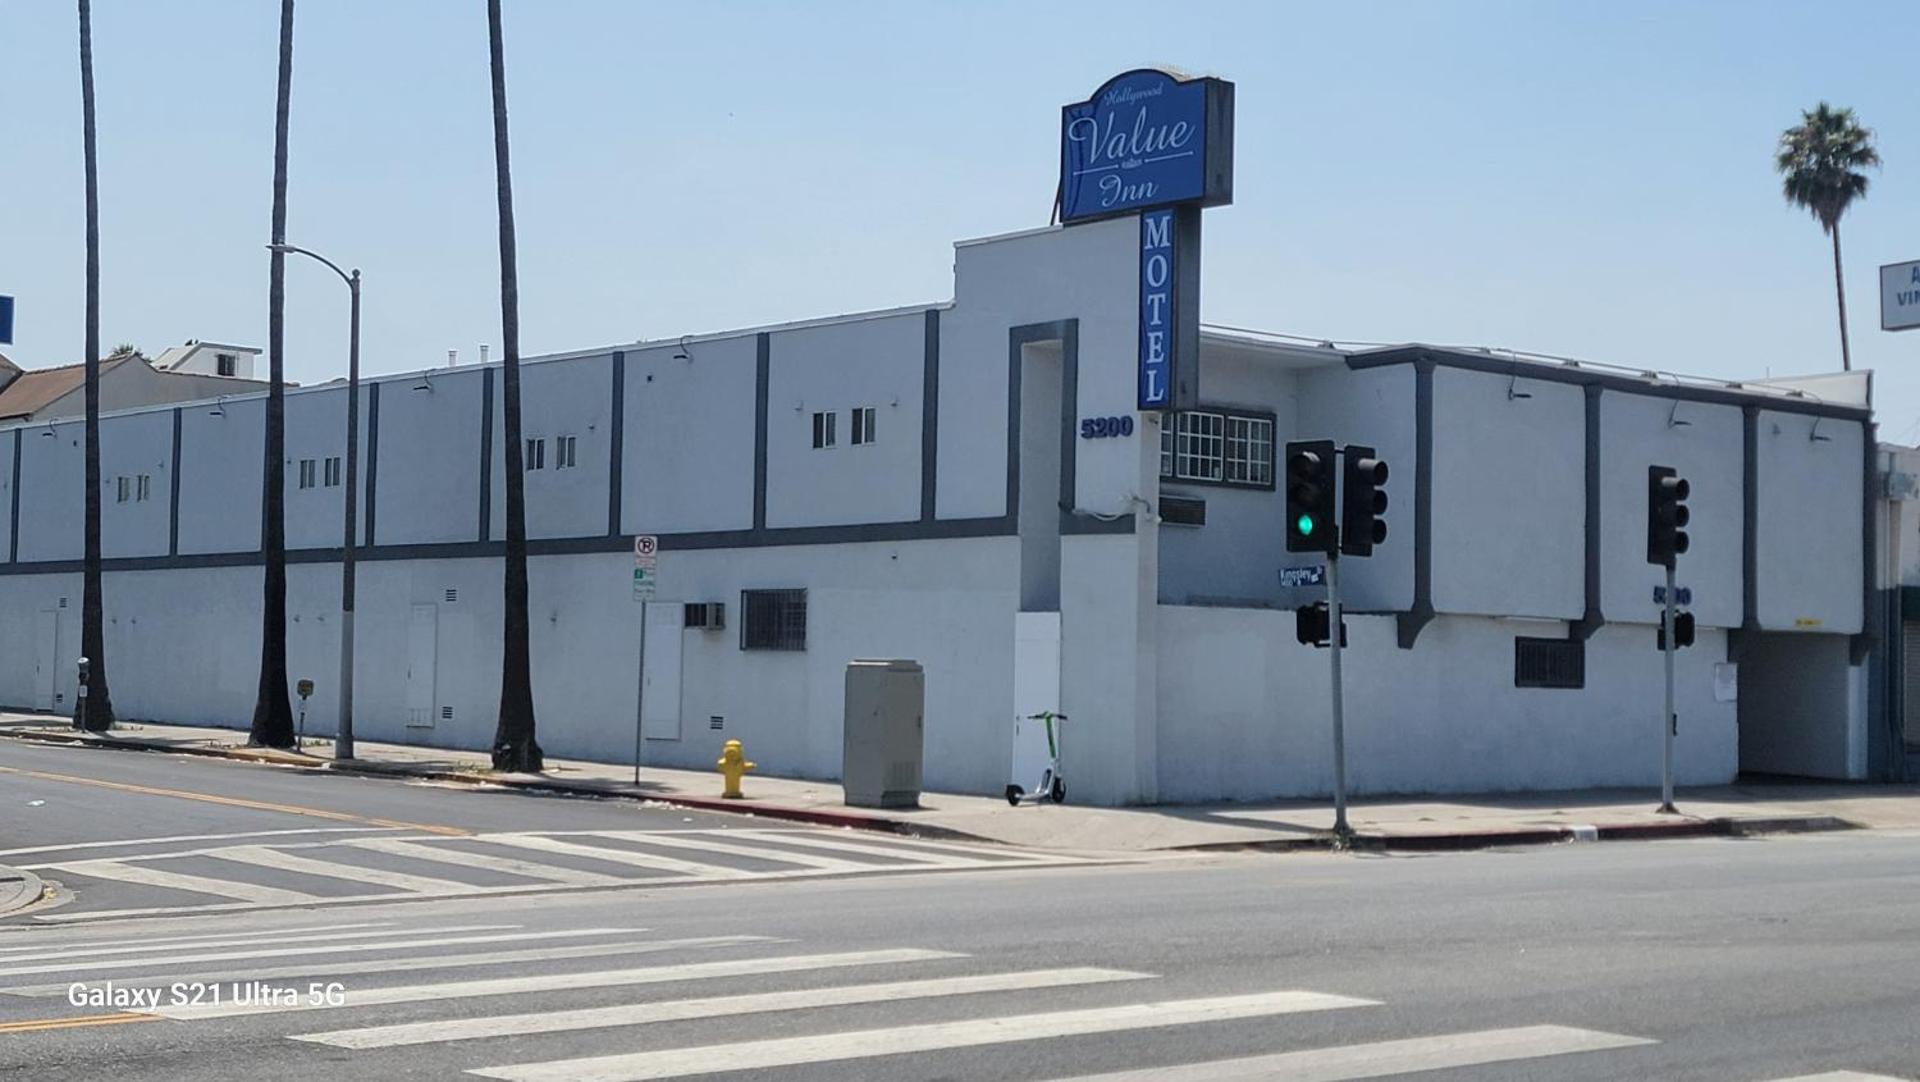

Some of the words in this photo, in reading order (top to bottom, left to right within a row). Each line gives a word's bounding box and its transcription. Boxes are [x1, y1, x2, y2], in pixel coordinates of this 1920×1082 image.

[1103, 82, 1164, 106] Hollywood
[1068, 106, 1196, 164] Value
[1099, 174, 1159, 207] Inn
[1144, 215, 1171, 403] MOTEL
[1081, 415, 1134, 439] 5200
